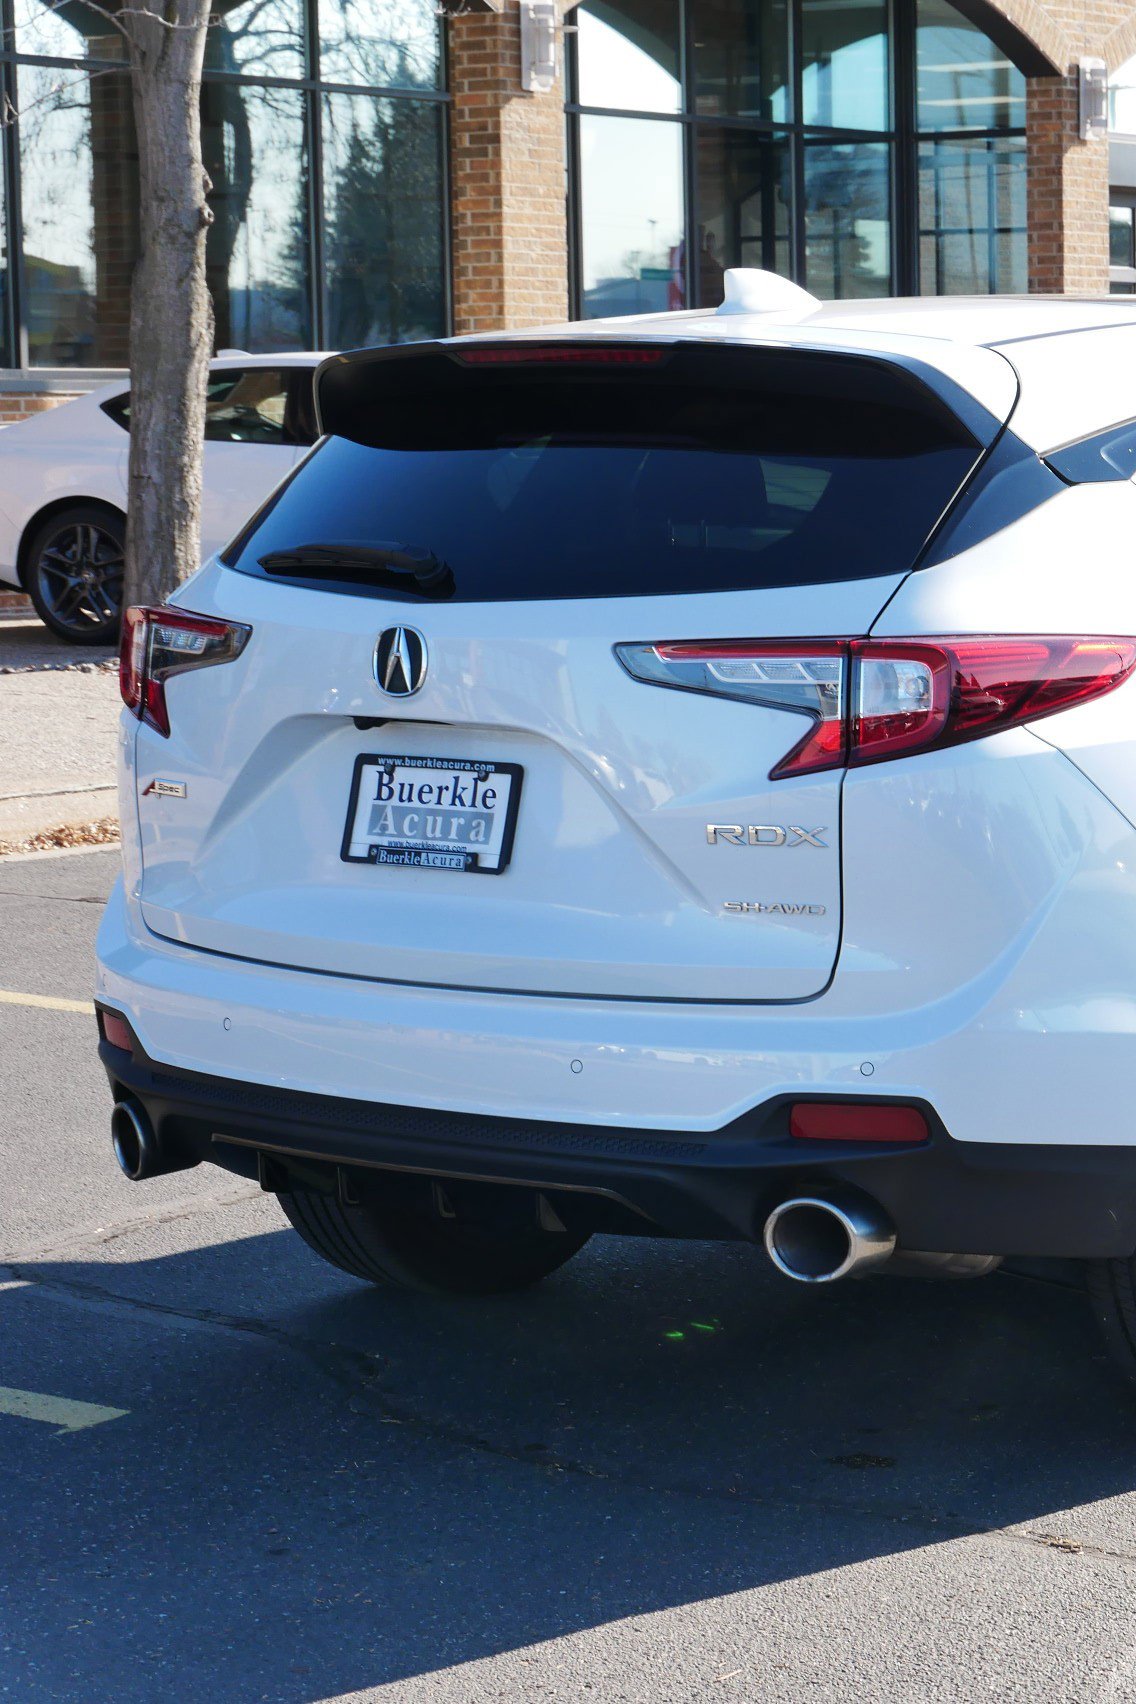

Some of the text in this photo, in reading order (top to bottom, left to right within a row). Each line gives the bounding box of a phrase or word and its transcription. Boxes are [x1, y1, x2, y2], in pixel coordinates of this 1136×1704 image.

[378, 757, 495, 772] www.buerkleacura.com
[373, 770, 497, 809] Buerkle
[372, 805, 486, 841] Acura
[706, 824, 829, 848] RDX
[723, 901, 826, 916] SH-AWD
